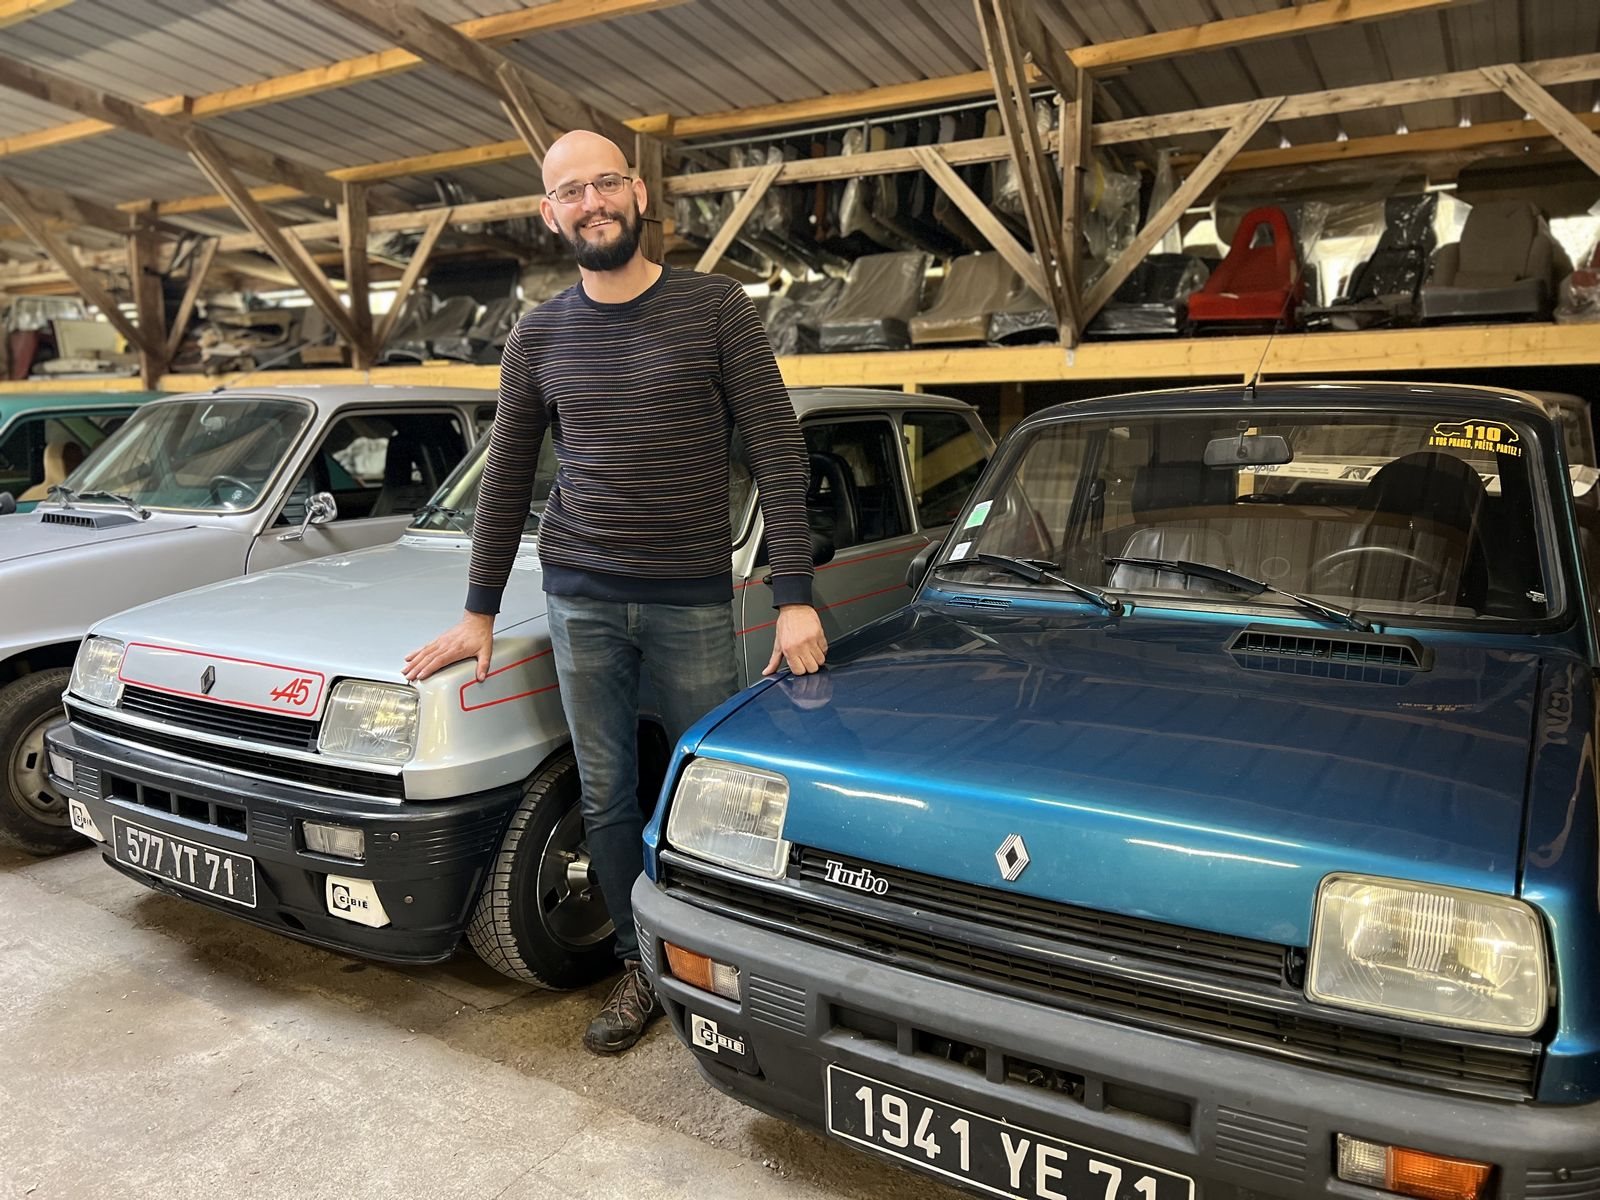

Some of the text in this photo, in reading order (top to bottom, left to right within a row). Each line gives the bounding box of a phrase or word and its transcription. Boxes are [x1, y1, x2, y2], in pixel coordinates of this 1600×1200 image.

[1435, 436, 1448, 446] VOS
[1496, 443, 1517, 456] PARTEZ
[1464, 425, 1501, 441] 110
[270, 677, 313, 706] A5
[126, 826, 234, 895] 577 YT 71
[824, 859, 889, 895] Turbo
[855, 1085, 970, 1172] 1941
[1000, 1131, 1068, 1200] YE
